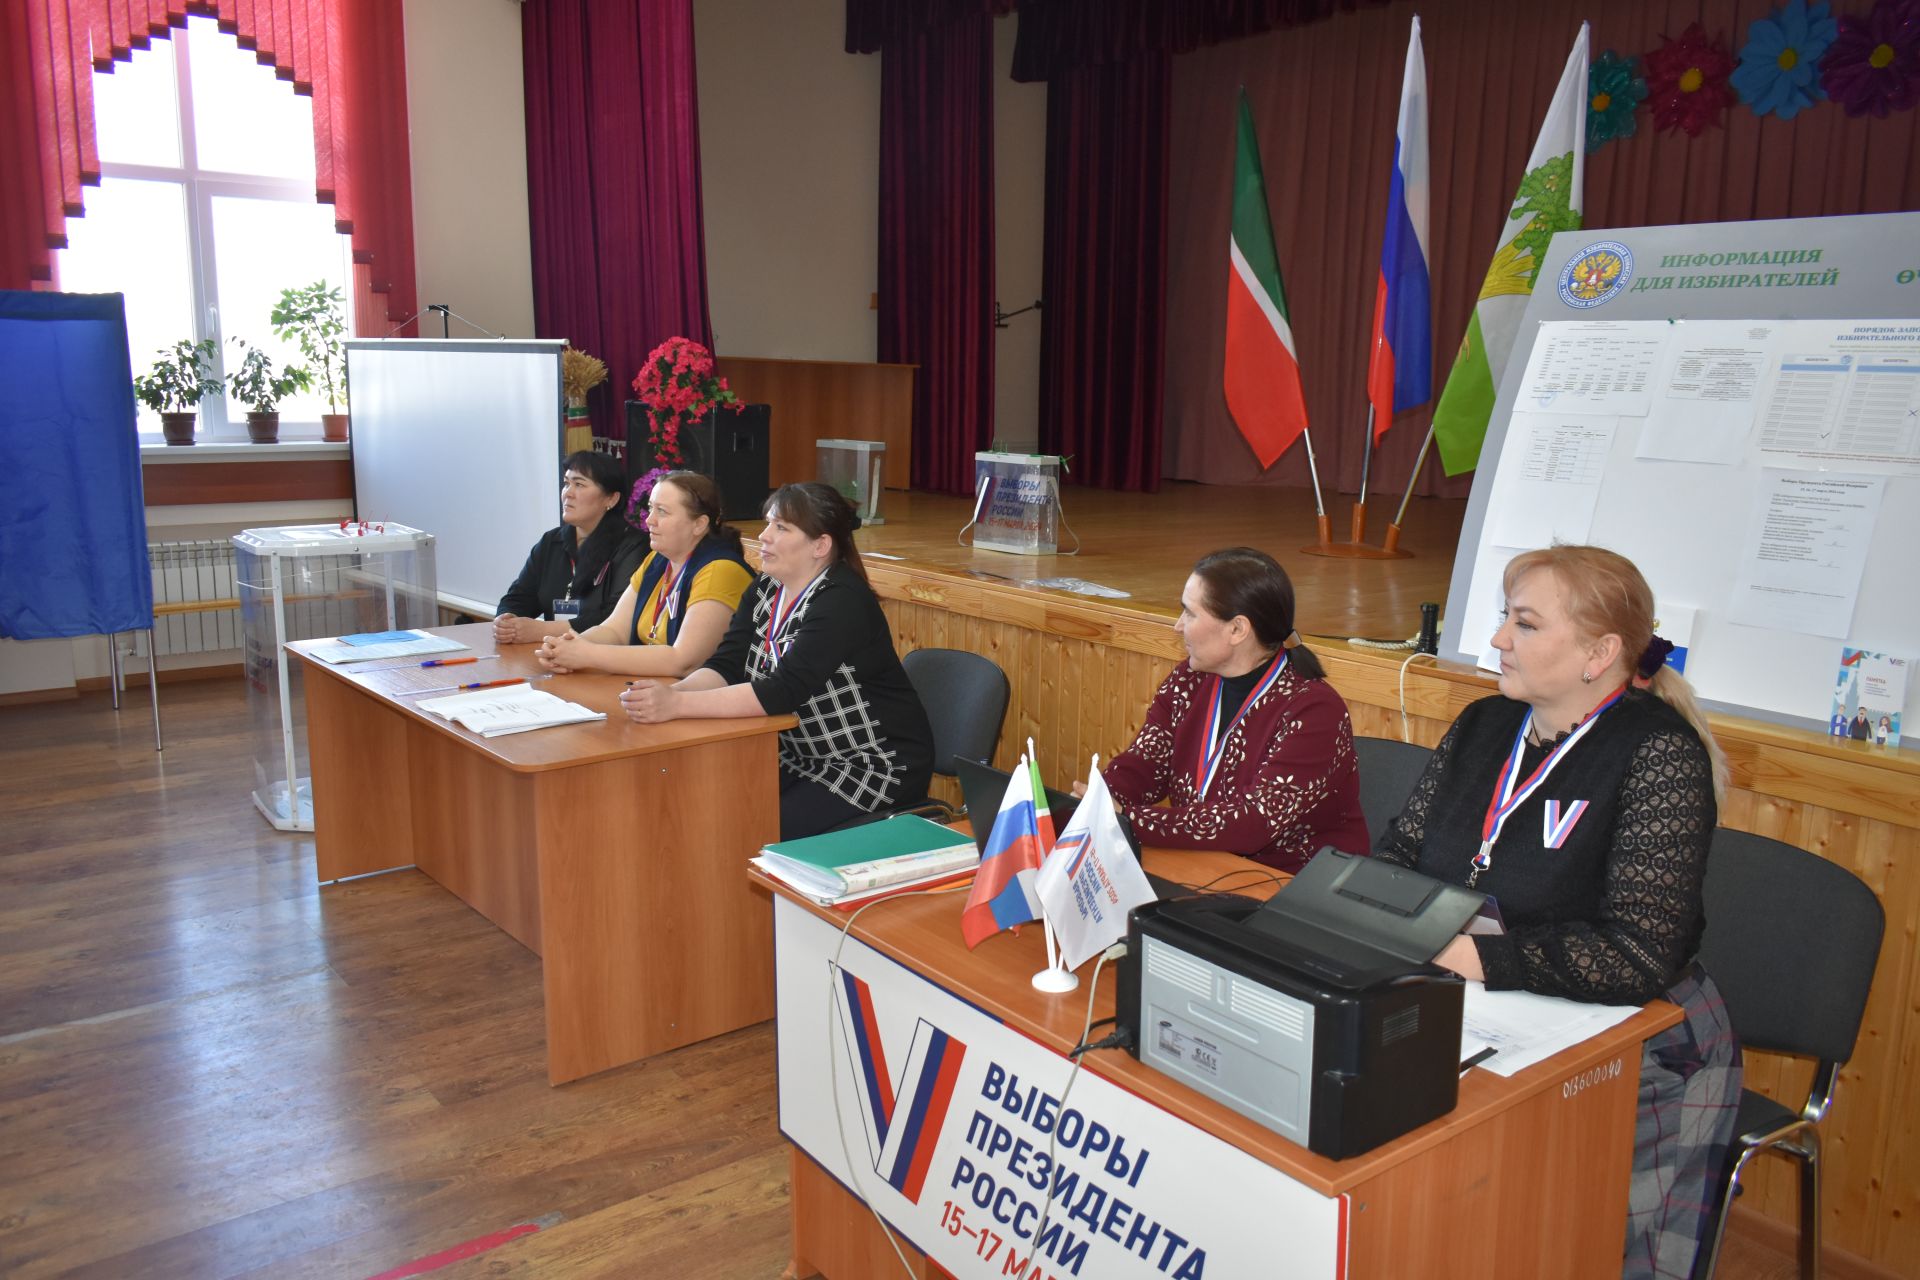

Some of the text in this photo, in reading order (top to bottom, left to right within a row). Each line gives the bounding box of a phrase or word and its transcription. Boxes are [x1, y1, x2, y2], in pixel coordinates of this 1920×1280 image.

[1660, 249, 1823, 268] ИНФОРМАЦИЯ
[1630, 268, 1839, 293] ДЛЯ ИЗБИРАТЕЛЕЙ
[1000, 478, 1040, 491] ВЫБОРЫ
[992, 504, 1024, 517] РОССИИ
[981, 1061, 1150, 1188] ВЫБОРЫ
[965, 1109, 1207, 1280] ПРЕЗИДЕНТА
[950, 1157, 1090, 1276] РОССИИ
